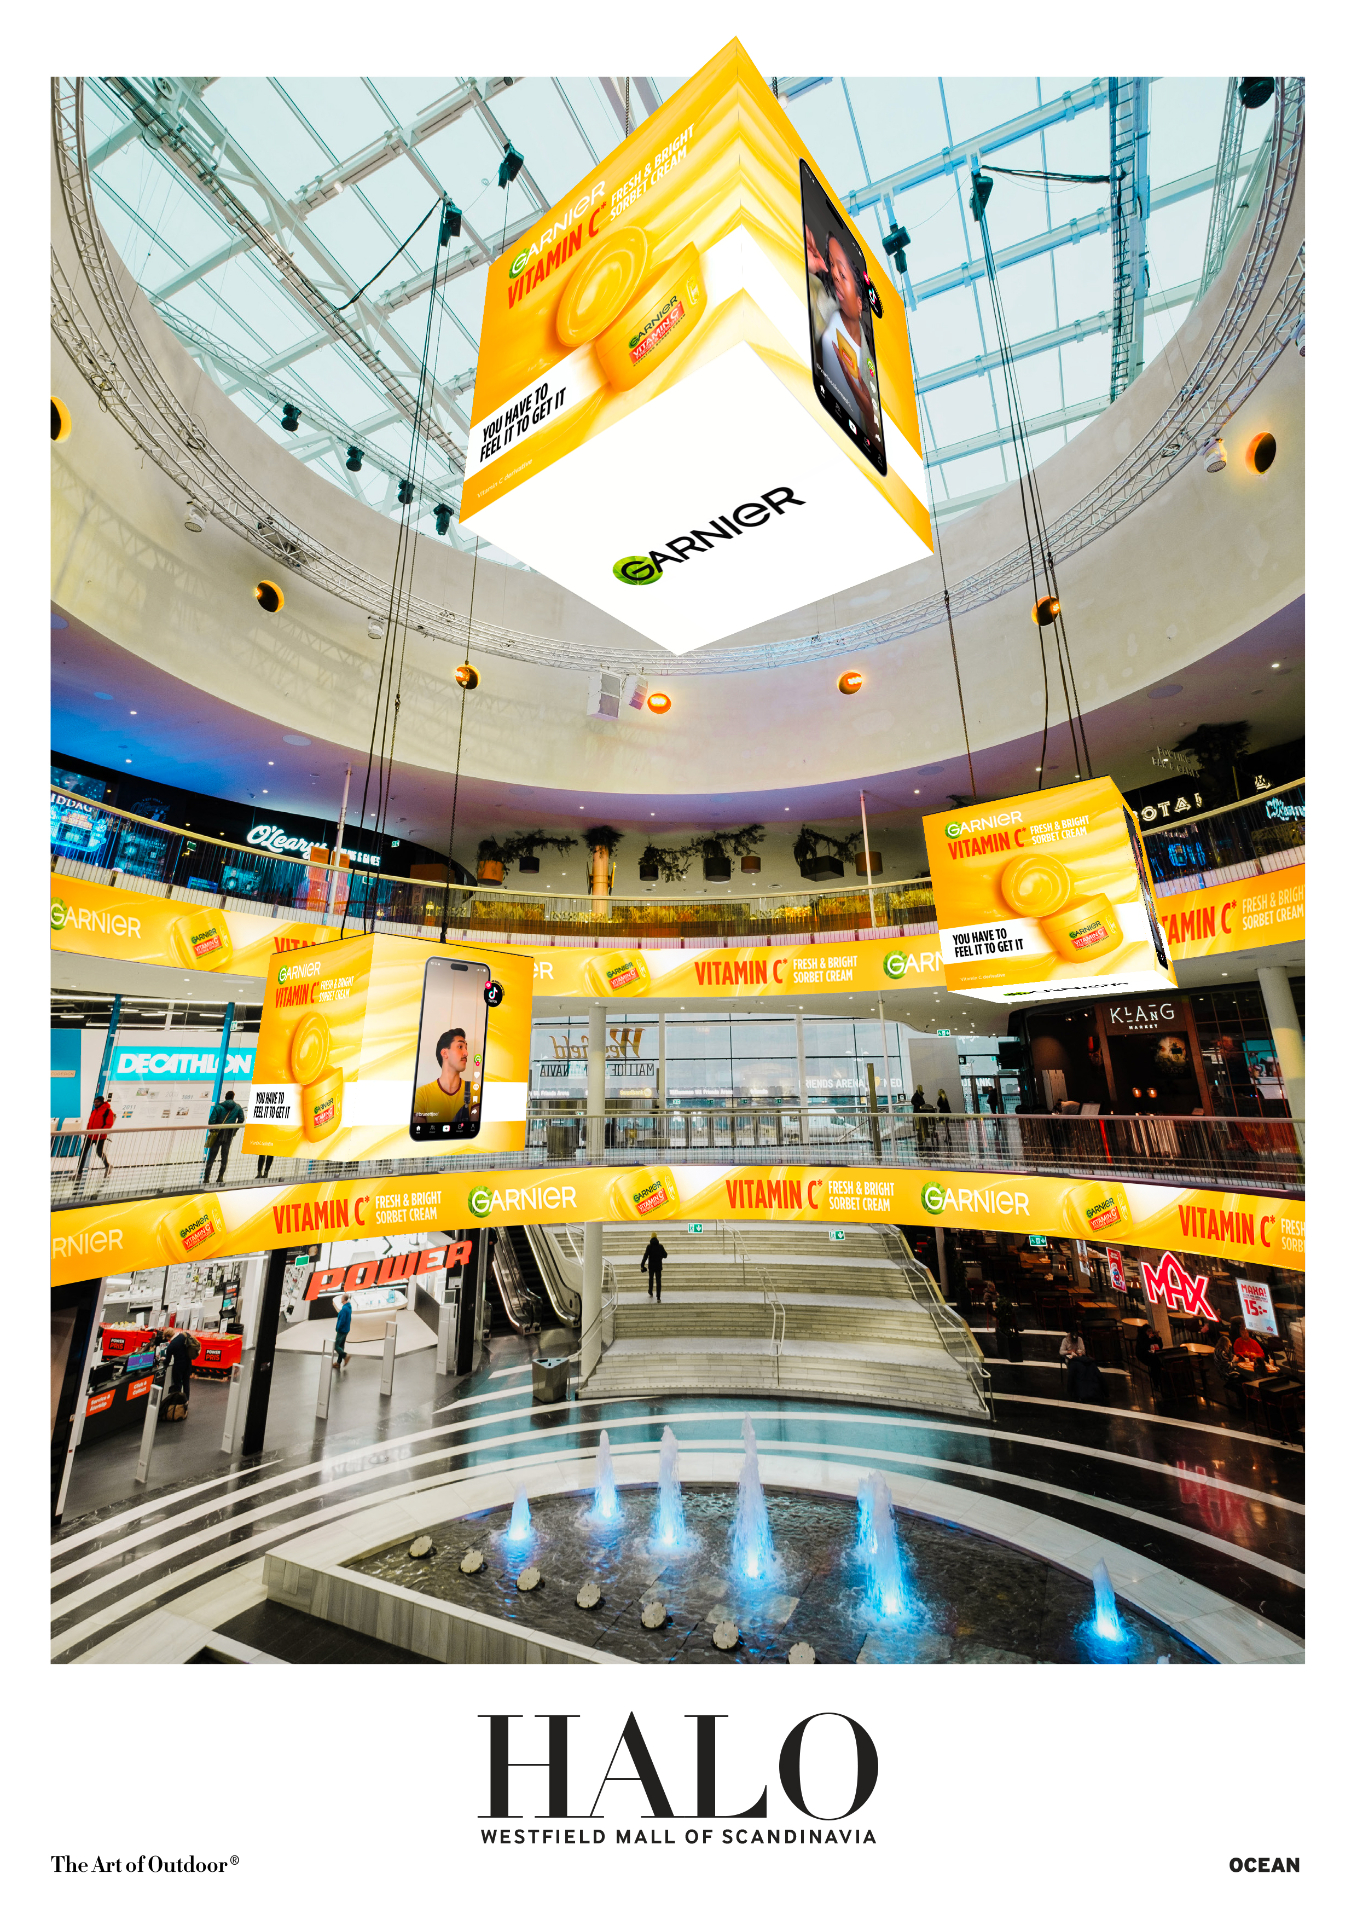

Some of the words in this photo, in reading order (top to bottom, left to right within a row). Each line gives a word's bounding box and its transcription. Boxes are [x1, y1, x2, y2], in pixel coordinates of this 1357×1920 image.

[611, 170, 642, 207] FRESH
[644, 162, 652, 178] &
[654, 123, 695, 169] BRIGHT
[610, 180, 648, 221] SORBET
[650, 145, 687, 186] CREAM
[508, 223, 583, 309] VITAMIN
[633, 318, 670, 356] VITAMIN
[483, 415, 503, 443] YOU
[505, 393, 532, 427] HAVE
[535, 382, 548, 405] TO
[480, 434, 501, 463] FEEL
[504, 424, 514, 446] IT
[517, 414, 529, 437] TO
[532, 396, 553, 425] GET
[555, 386, 566, 410] IT
[1030, 822, 1053, 835] FRESH
[1054, 821, 1061, 831] &
[1062, 815, 1089, 830] BRIGHT
[1031, 832, 1060, 845] SORBET
[1061, 826, 1088, 840] CREAM
[947, 831, 1011, 860] VITAMIN
[1242, 894, 1268, 914] FRESH
[1270, 891, 1276, 906] &
[1242, 910, 1273, 931] SORBET
[1276, 903, 1305, 923] CREAM
[952, 933, 970, 946] YOU
[972, 929, 994, 943] HAVE
[996, 927, 1007, 940] TO
[954, 945, 974, 958] FEEL
[975, 944, 983, 956] IT
[984, 942, 996, 954] TO
[998, 940, 1013, 953] GET
[1015, 938, 1023, 950] IT
[694, 960, 767, 986] VITAMIN
[793, 958, 817, 970] FRESH
[819, 957, 826, 969] &
[828, 955, 858, 968] BRIGHT
[885, 951, 944, 976] GARN
[793, 971, 823, 983] SORBET
[826, 969, 853, 982] CREAM
[275, 983, 309, 1008] VITAMIN
[1110, 1003, 1175, 1024] KLANG
[117, 1053, 252, 1074] DECATHLON
[835, 1078, 864, 1088] ARENA
[278, 1092, 284, 1104] TO
[253, 1106, 263, 1118] FEEL
[276, 1106, 285, 1118] GET
[726, 1179, 803, 1209] VITAMIN
[828, 1180, 853, 1195] FRESH
[856, 1182, 862, 1195] &
[864, 1181, 894, 1196] BRIGHT
[375, 1195, 400, 1209] FRESH
[403, 1193, 410, 1206] &
[411, 1191, 442, 1206] BRIGHT
[829, 1196, 860, 1210] SORBET
[862, 1198, 890, 1212] CREAM
[273, 1199, 349, 1234] VITAMIN
[376, 1209, 407, 1224] SORBET
[409, 1207, 437, 1221] CREAM
[1178, 1204, 1255, 1246] VITAMIN
[1281, 1218, 1305, 1237] FRESH
[304, 1240, 473, 1301] POWER
[1140, 1250, 1220, 1322] MAX
